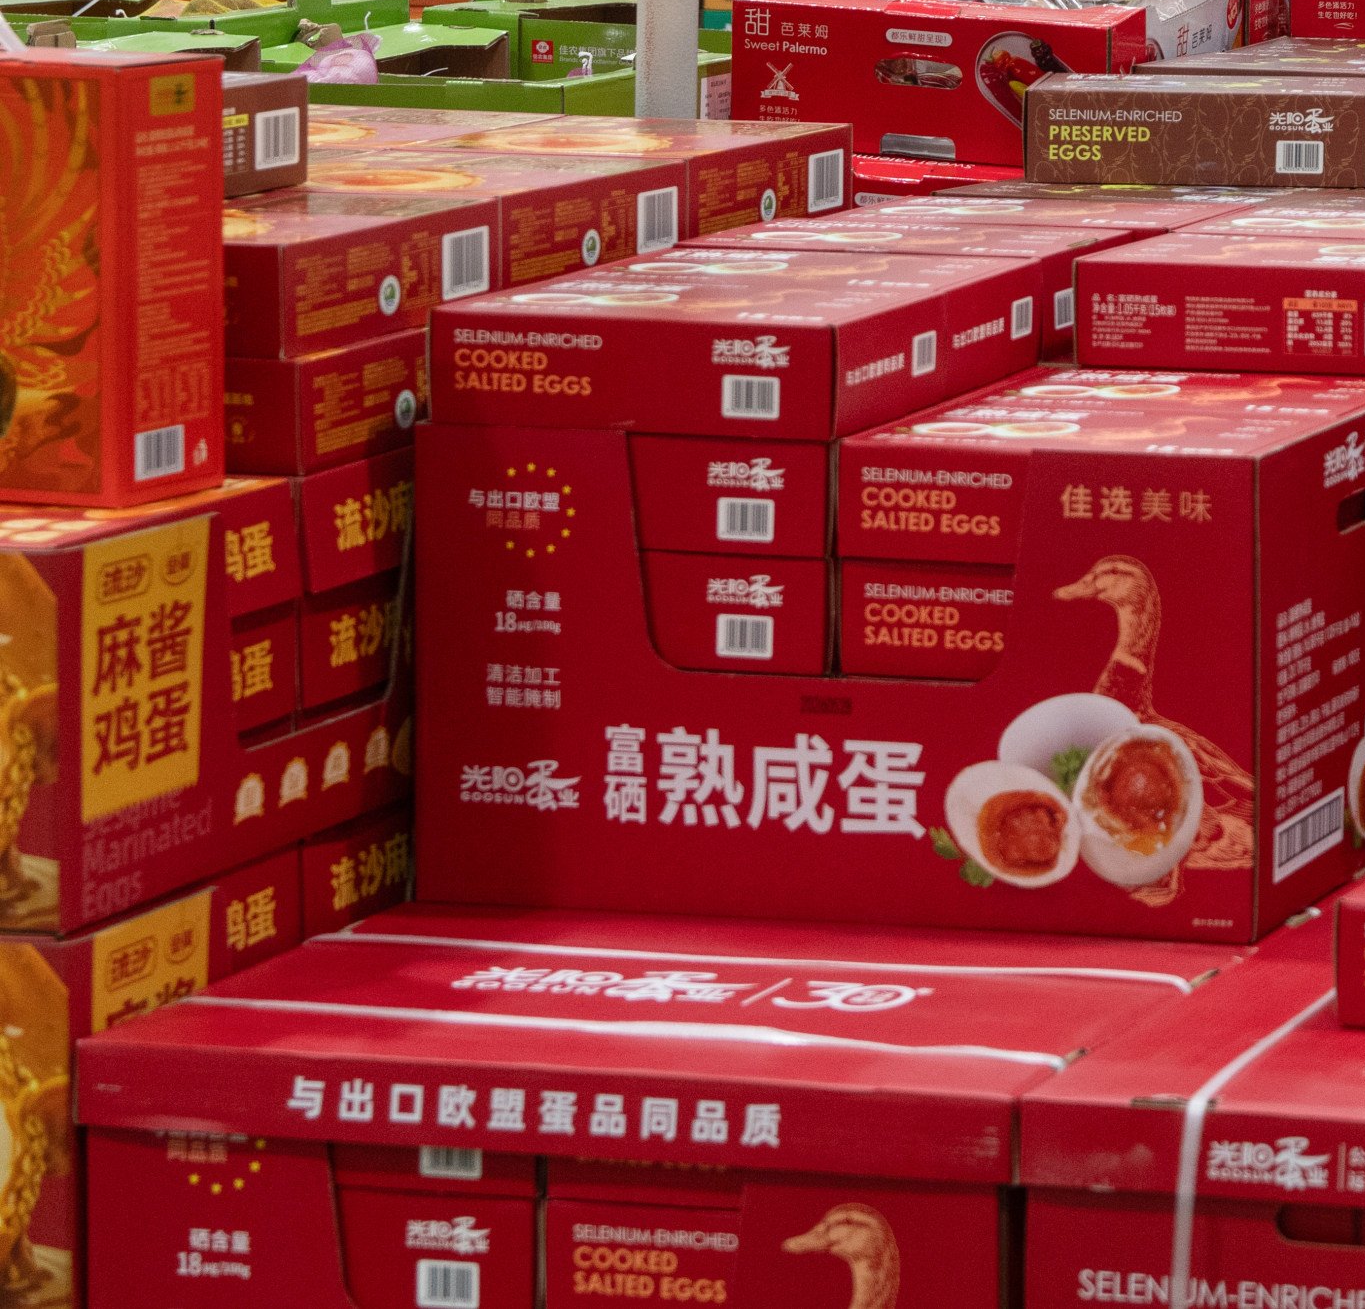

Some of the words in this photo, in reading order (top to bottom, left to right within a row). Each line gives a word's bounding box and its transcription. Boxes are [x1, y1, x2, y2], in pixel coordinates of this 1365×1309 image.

[744, 8, 772, 36] 甜
[780, 21, 829, 40] 芭莱姆
[744, 38, 781, 52] Sweet
[782, 41, 828, 56] Palermo
[1048, 108, 1183, 123] SELENIUM-ENRICHED
[1048, 126, 1151, 143] PRESERVED
[1048, 144, 1102, 161] EGGS
[453, 327, 603, 351] SELENIUM-ENRICHED
[454, 349, 548, 372] COOKED
[454, 370, 529, 394] SALTED
[533, 373, 593, 396] EGGS
[861, 466, 1013, 490] SELENIUM-ENRICHED
[468, 488, 561, 512] 与出口欧盟
[861, 487, 957, 510] COOKED
[1061, 483, 1213, 524] 佳选美味
[861, 509, 936, 532] SALTED
[939, 513, 1001, 537] EGGS
[506, 590, 562, 612] 硒含量
[864, 582, 1014, 606] SELENIUM-ENRICHED
[864, 603, 960, 627] COOKED
[92, 598, 193, 697] 麻酱
[864, 625, 939, 648] SALTED
[943, 629, 1005, 652] EGGS
[92, 679, 192, 777] 鸡蛋
[603, 723, 926, 839] 富硒熟咸蛋
[460, 791, 525, 805] GOOSUN
[286, 1075, 781, 1149] 与出口欧盟蛋品同品质
[572, 1222, 739, 1252] SELENIUM-ENRICHED
[573, 1246, 679, 1272] COOKED
[573, 1271, 655, 1298] SALTED
[659, 1277, 728, 1303] EGGS
